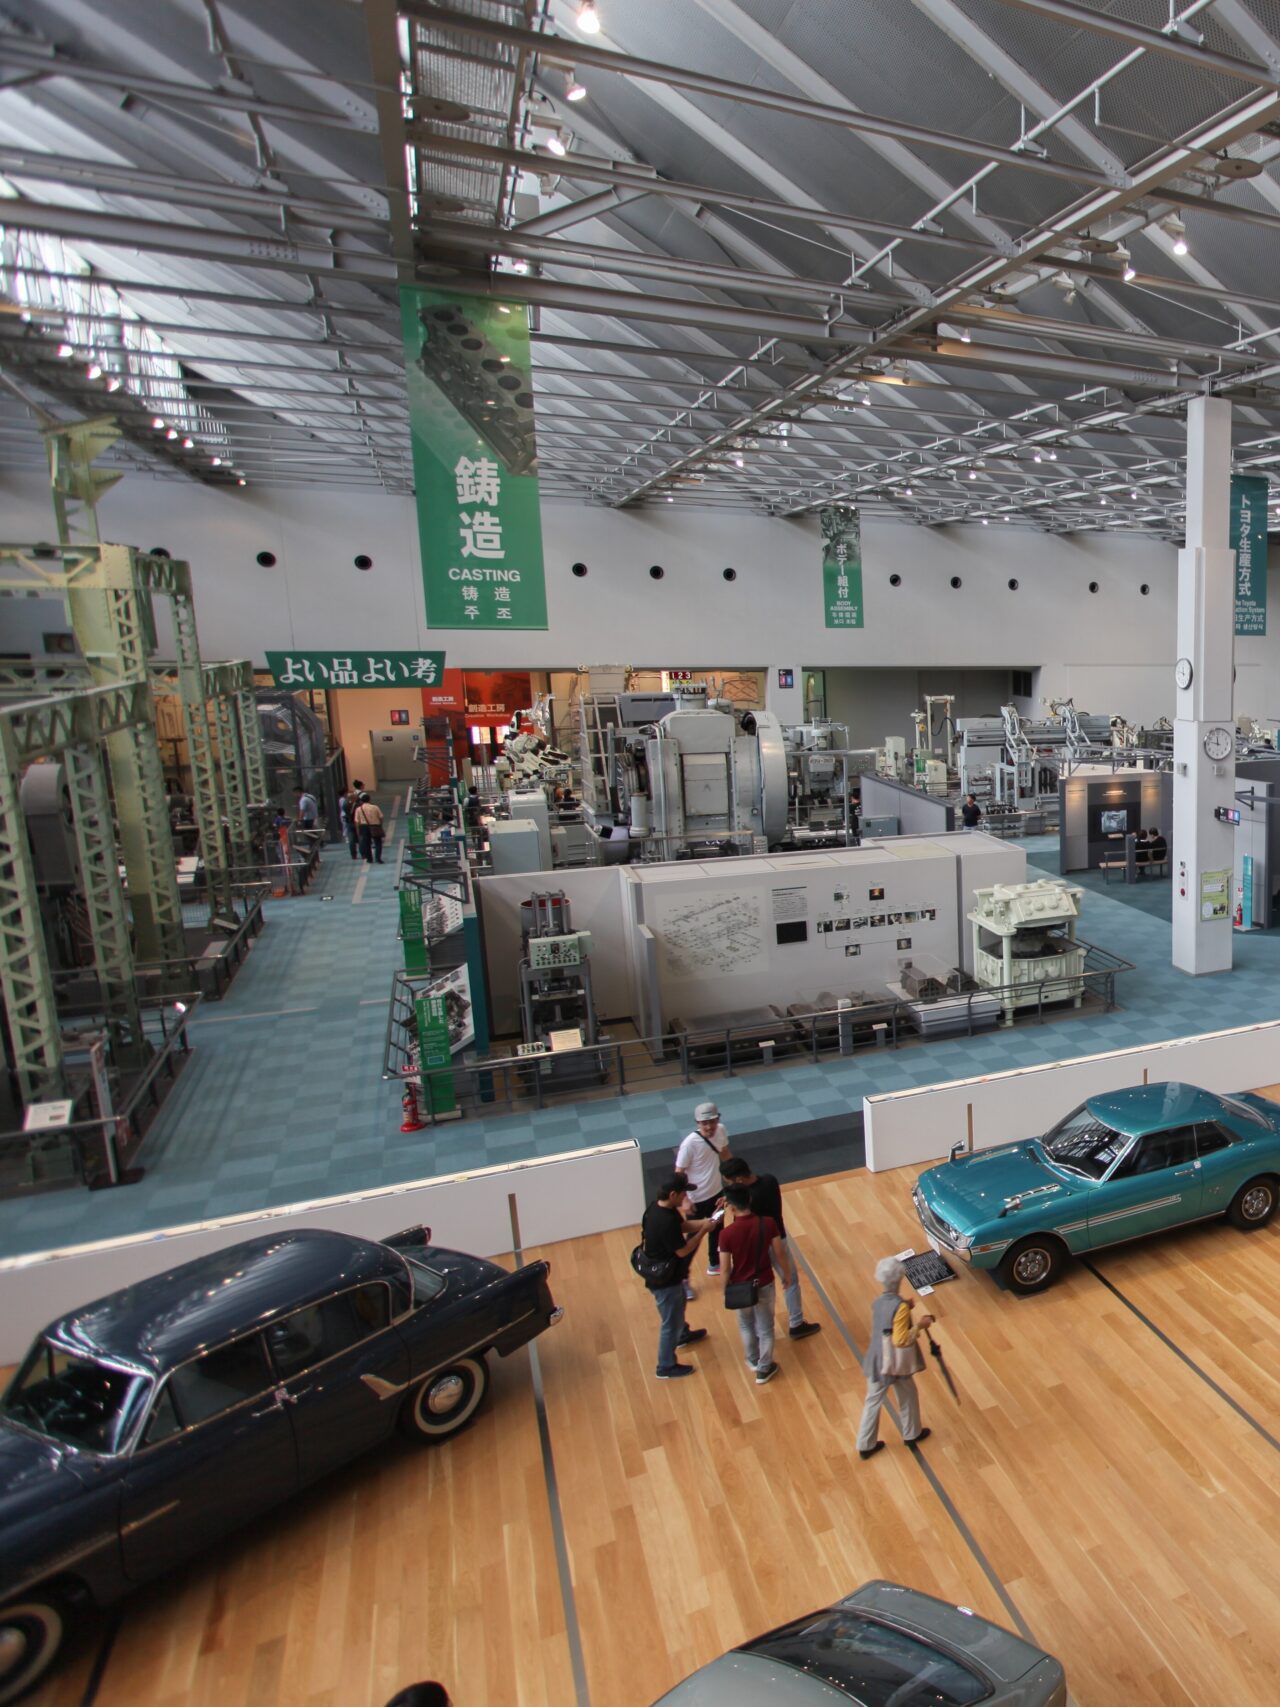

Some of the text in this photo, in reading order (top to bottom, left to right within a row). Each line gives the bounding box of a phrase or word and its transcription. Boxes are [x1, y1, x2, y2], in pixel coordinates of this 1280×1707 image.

[454, 456, 506, 559] 鋳造
[836, 543, 849, 599] ボデー組付
[1239, 494, 1251, 596] トヨタ生産方式
[448, 568, 521, 582] CASTING
[279, 656, 438, 685] よい品よい考
